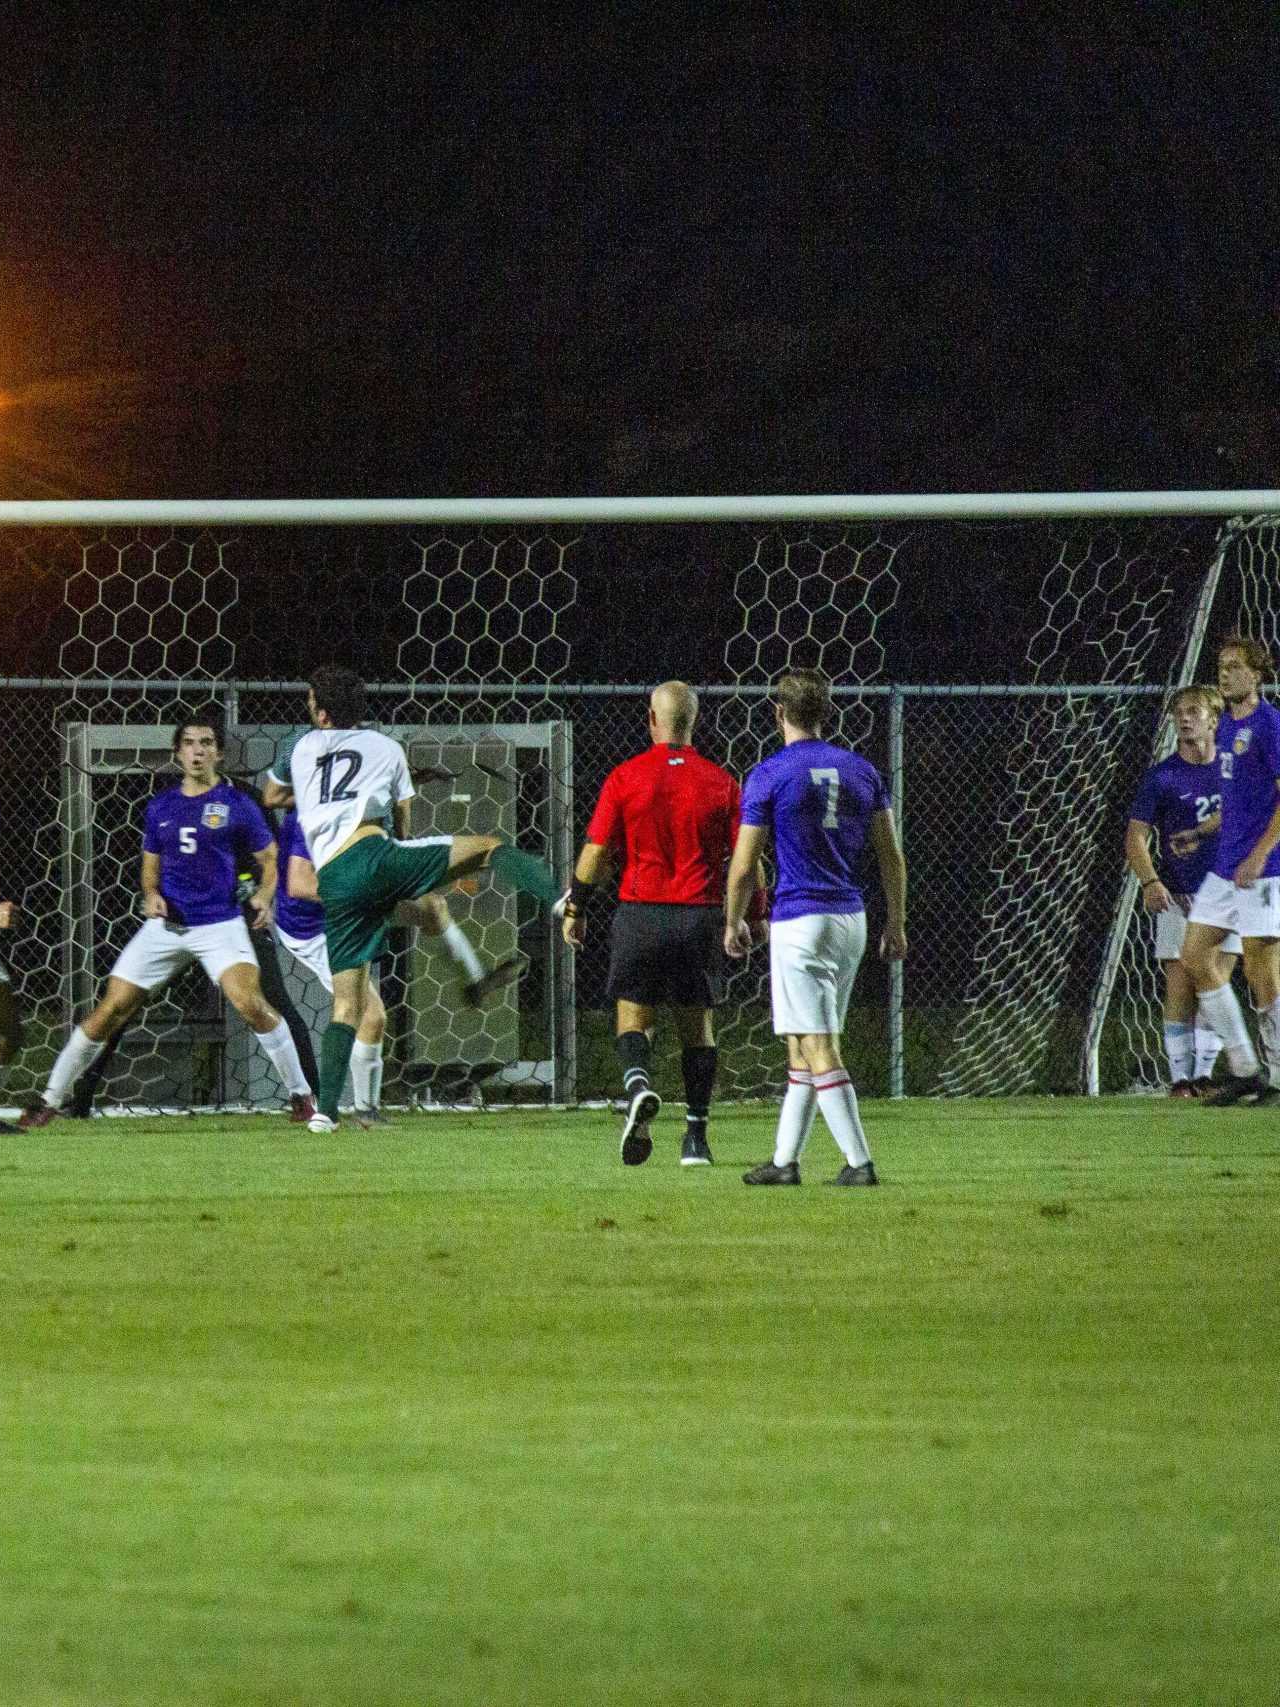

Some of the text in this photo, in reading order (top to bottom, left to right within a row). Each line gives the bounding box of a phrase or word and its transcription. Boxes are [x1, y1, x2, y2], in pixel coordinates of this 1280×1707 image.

[316, 749, 363, 804] 12
[809, 768, 839, 829] 7
[179, 827, 197, 854] 5
